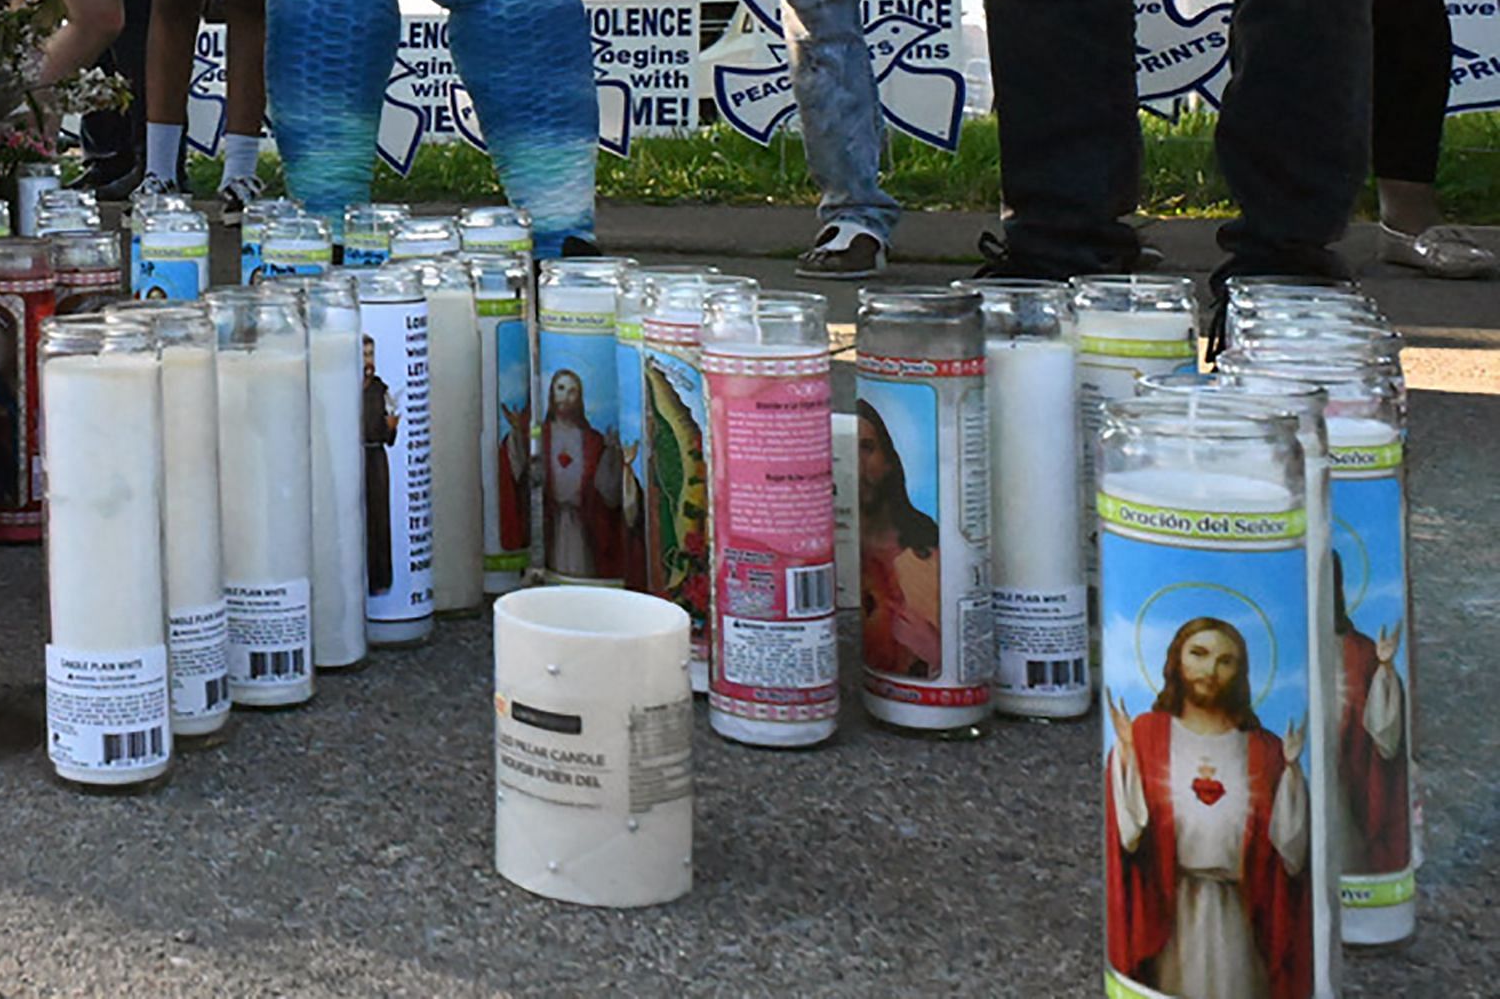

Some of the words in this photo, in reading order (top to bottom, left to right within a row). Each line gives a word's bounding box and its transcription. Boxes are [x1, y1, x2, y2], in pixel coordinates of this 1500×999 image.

[587, 7, 692, 38] OLENCE
[1446, 3, 1496, 17] ave
[415, 56, 452, 79] gin
[630, 69, 689, 89] with
[731, 76, 792, 107] PEAC
[632, 97, 689, 127] ME!
[1118, 506, 1190, 533] Oración
[1196, 516, 1229, 534] del
[1235, 518, 1287, 537] Señor
[550, 749, 605, 767] CANDLE
